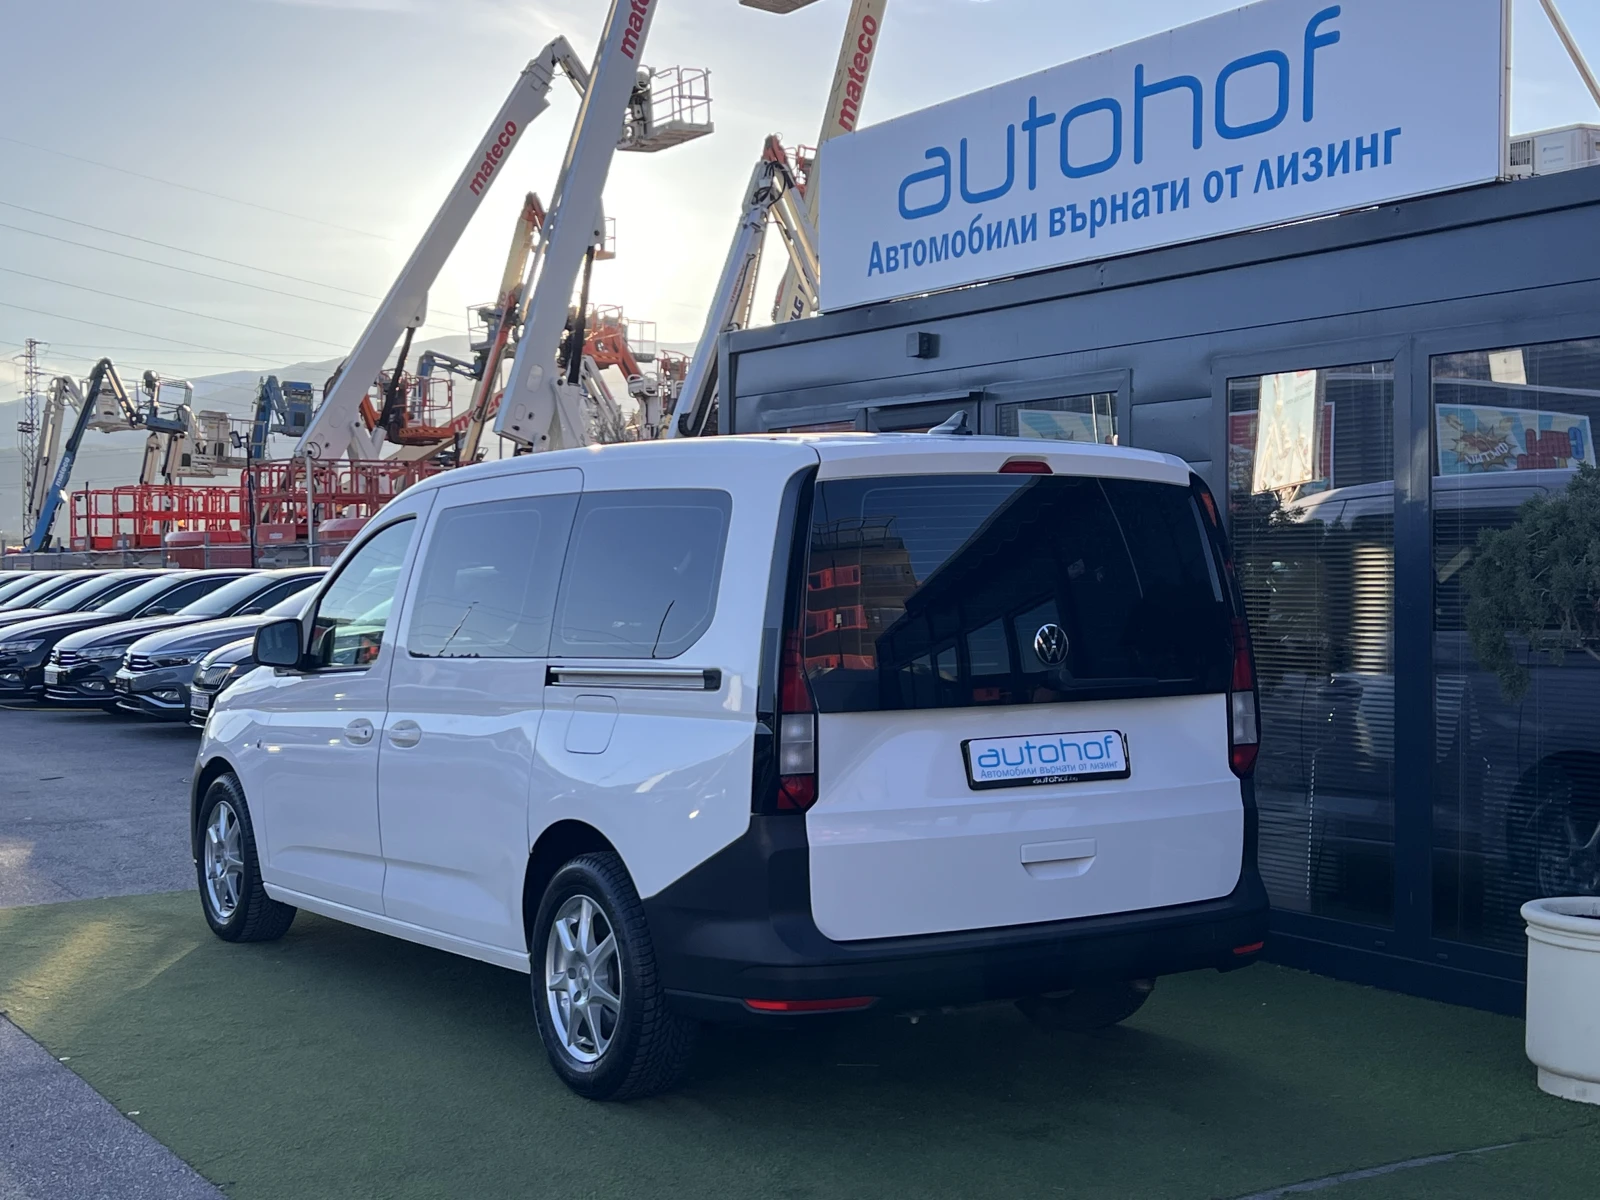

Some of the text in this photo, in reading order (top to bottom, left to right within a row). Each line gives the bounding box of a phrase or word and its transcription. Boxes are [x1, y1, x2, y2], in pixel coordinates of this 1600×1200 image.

[838, 14, 878, 133] mateco
[897, 4, 1342, 221] autohof
[469, 120, 517, 197] mateco
[867, 126, 1403, 278] Автомобили върнати от лизинг
[55, 457, 70, 487] mateco
[977, 735, 1113, 768] autohof
[980, 760, 1118, 778] Автомобили върнати от лизинг
